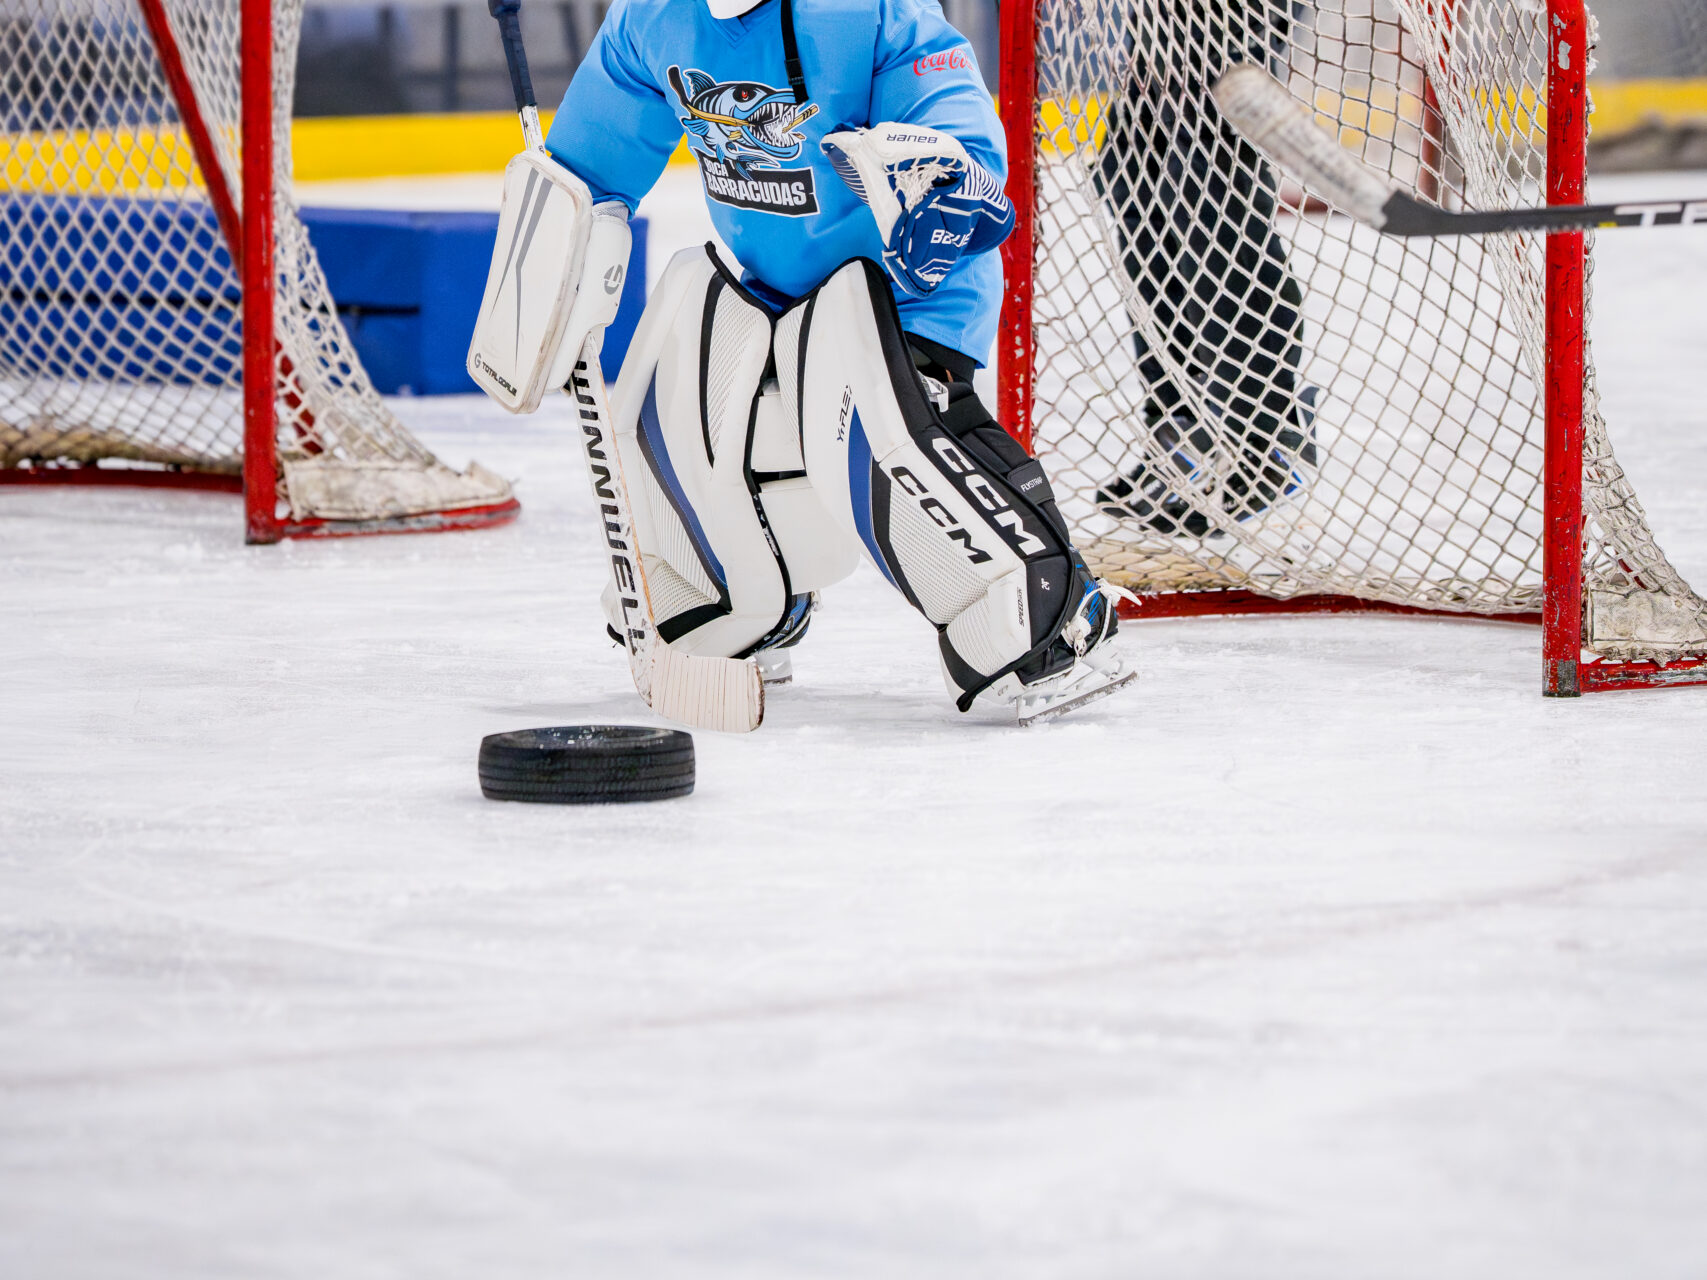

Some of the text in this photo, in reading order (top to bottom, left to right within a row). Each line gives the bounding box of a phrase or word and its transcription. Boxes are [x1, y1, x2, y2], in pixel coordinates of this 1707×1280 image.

[886, 132, 938, 145] BAUER
[705, 170, 808, 207] BARRACUDAS
[573, 360, 646, 657] WINNWELL
[890, 465, 993, 565] CCM
[931, 437, 1047, 556] CCM
[1020, 476, 1043, 492] FLYSTRAP
